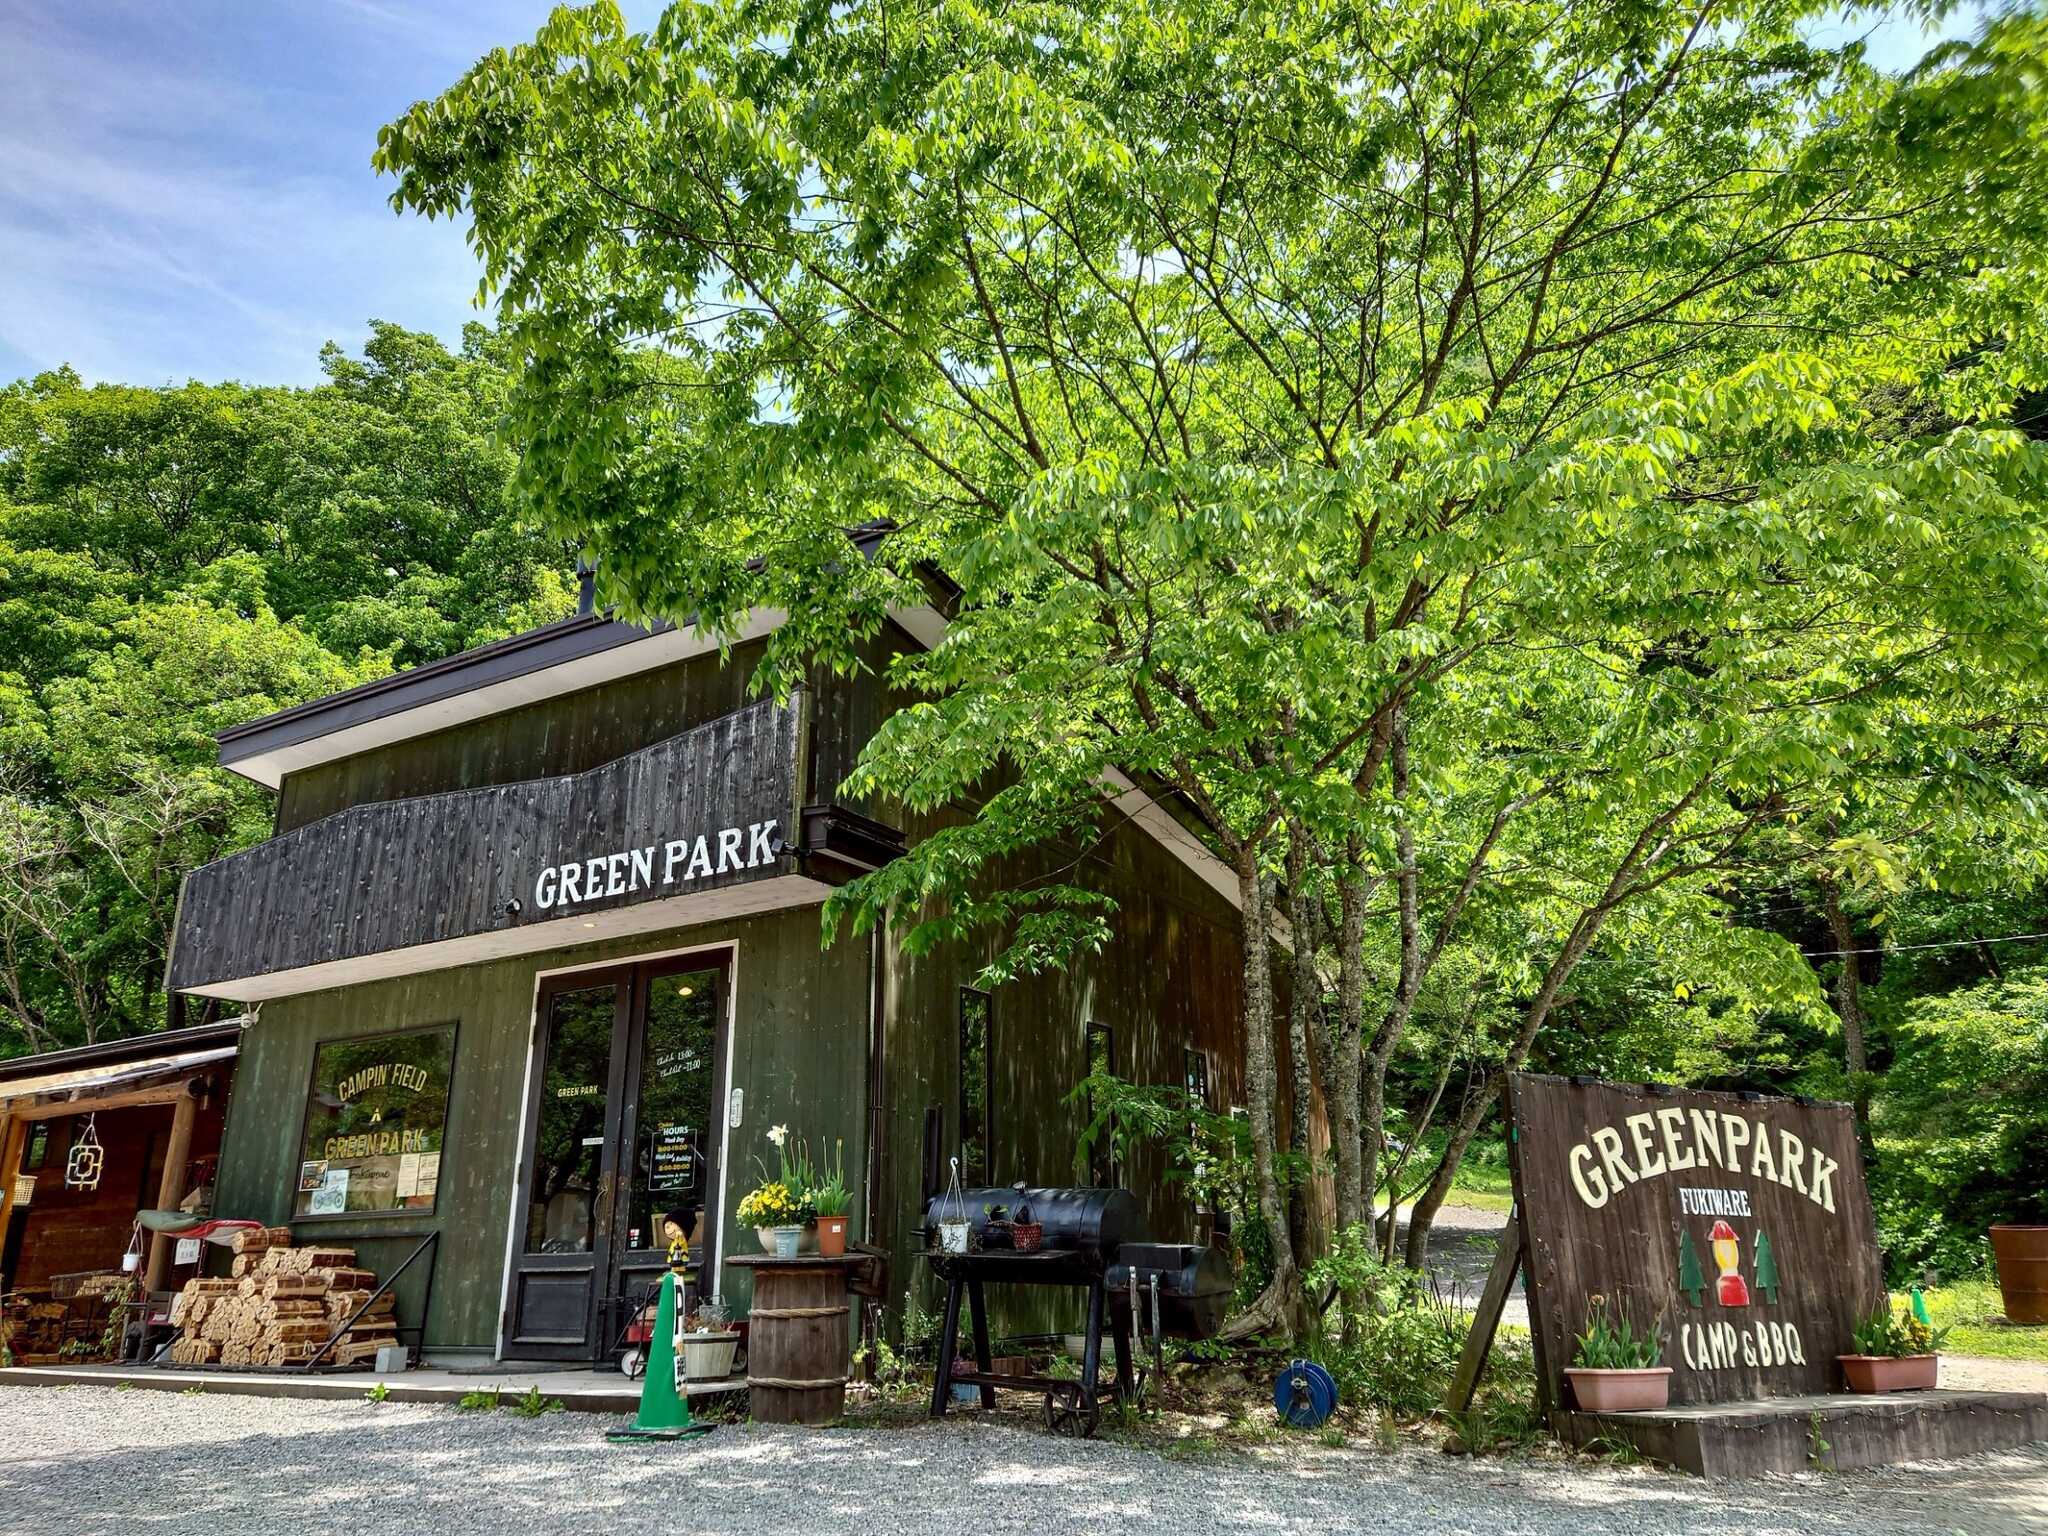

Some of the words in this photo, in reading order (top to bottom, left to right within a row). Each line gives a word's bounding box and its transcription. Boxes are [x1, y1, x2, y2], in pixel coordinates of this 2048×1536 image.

[535, 846, 655, 910] GREEN
[662, 818, 778, 885] PARK
[338, 1063, 392, 1102] CAMPIN'
[391, 1063, 428, 1093] FIELD
[557, 1088, 580, 1098] GREEN
[580, 1085, 599, 1095] PARK
[324, 1132, 379, 1161] GREEN
[379, 1128, 424, 1155] PARK
[663, 1125, 689, 1136] HOURS
[1568, 1106, 1839, 1215] GREENPARK
[1678, 1186, 1753, 1218] FUKIWARE
[1680, 1321, 1739, 1371] CAMP
[1742, 1329, 1757, 1368] &
[1757, 1320, 1807, 1367] BBQ
